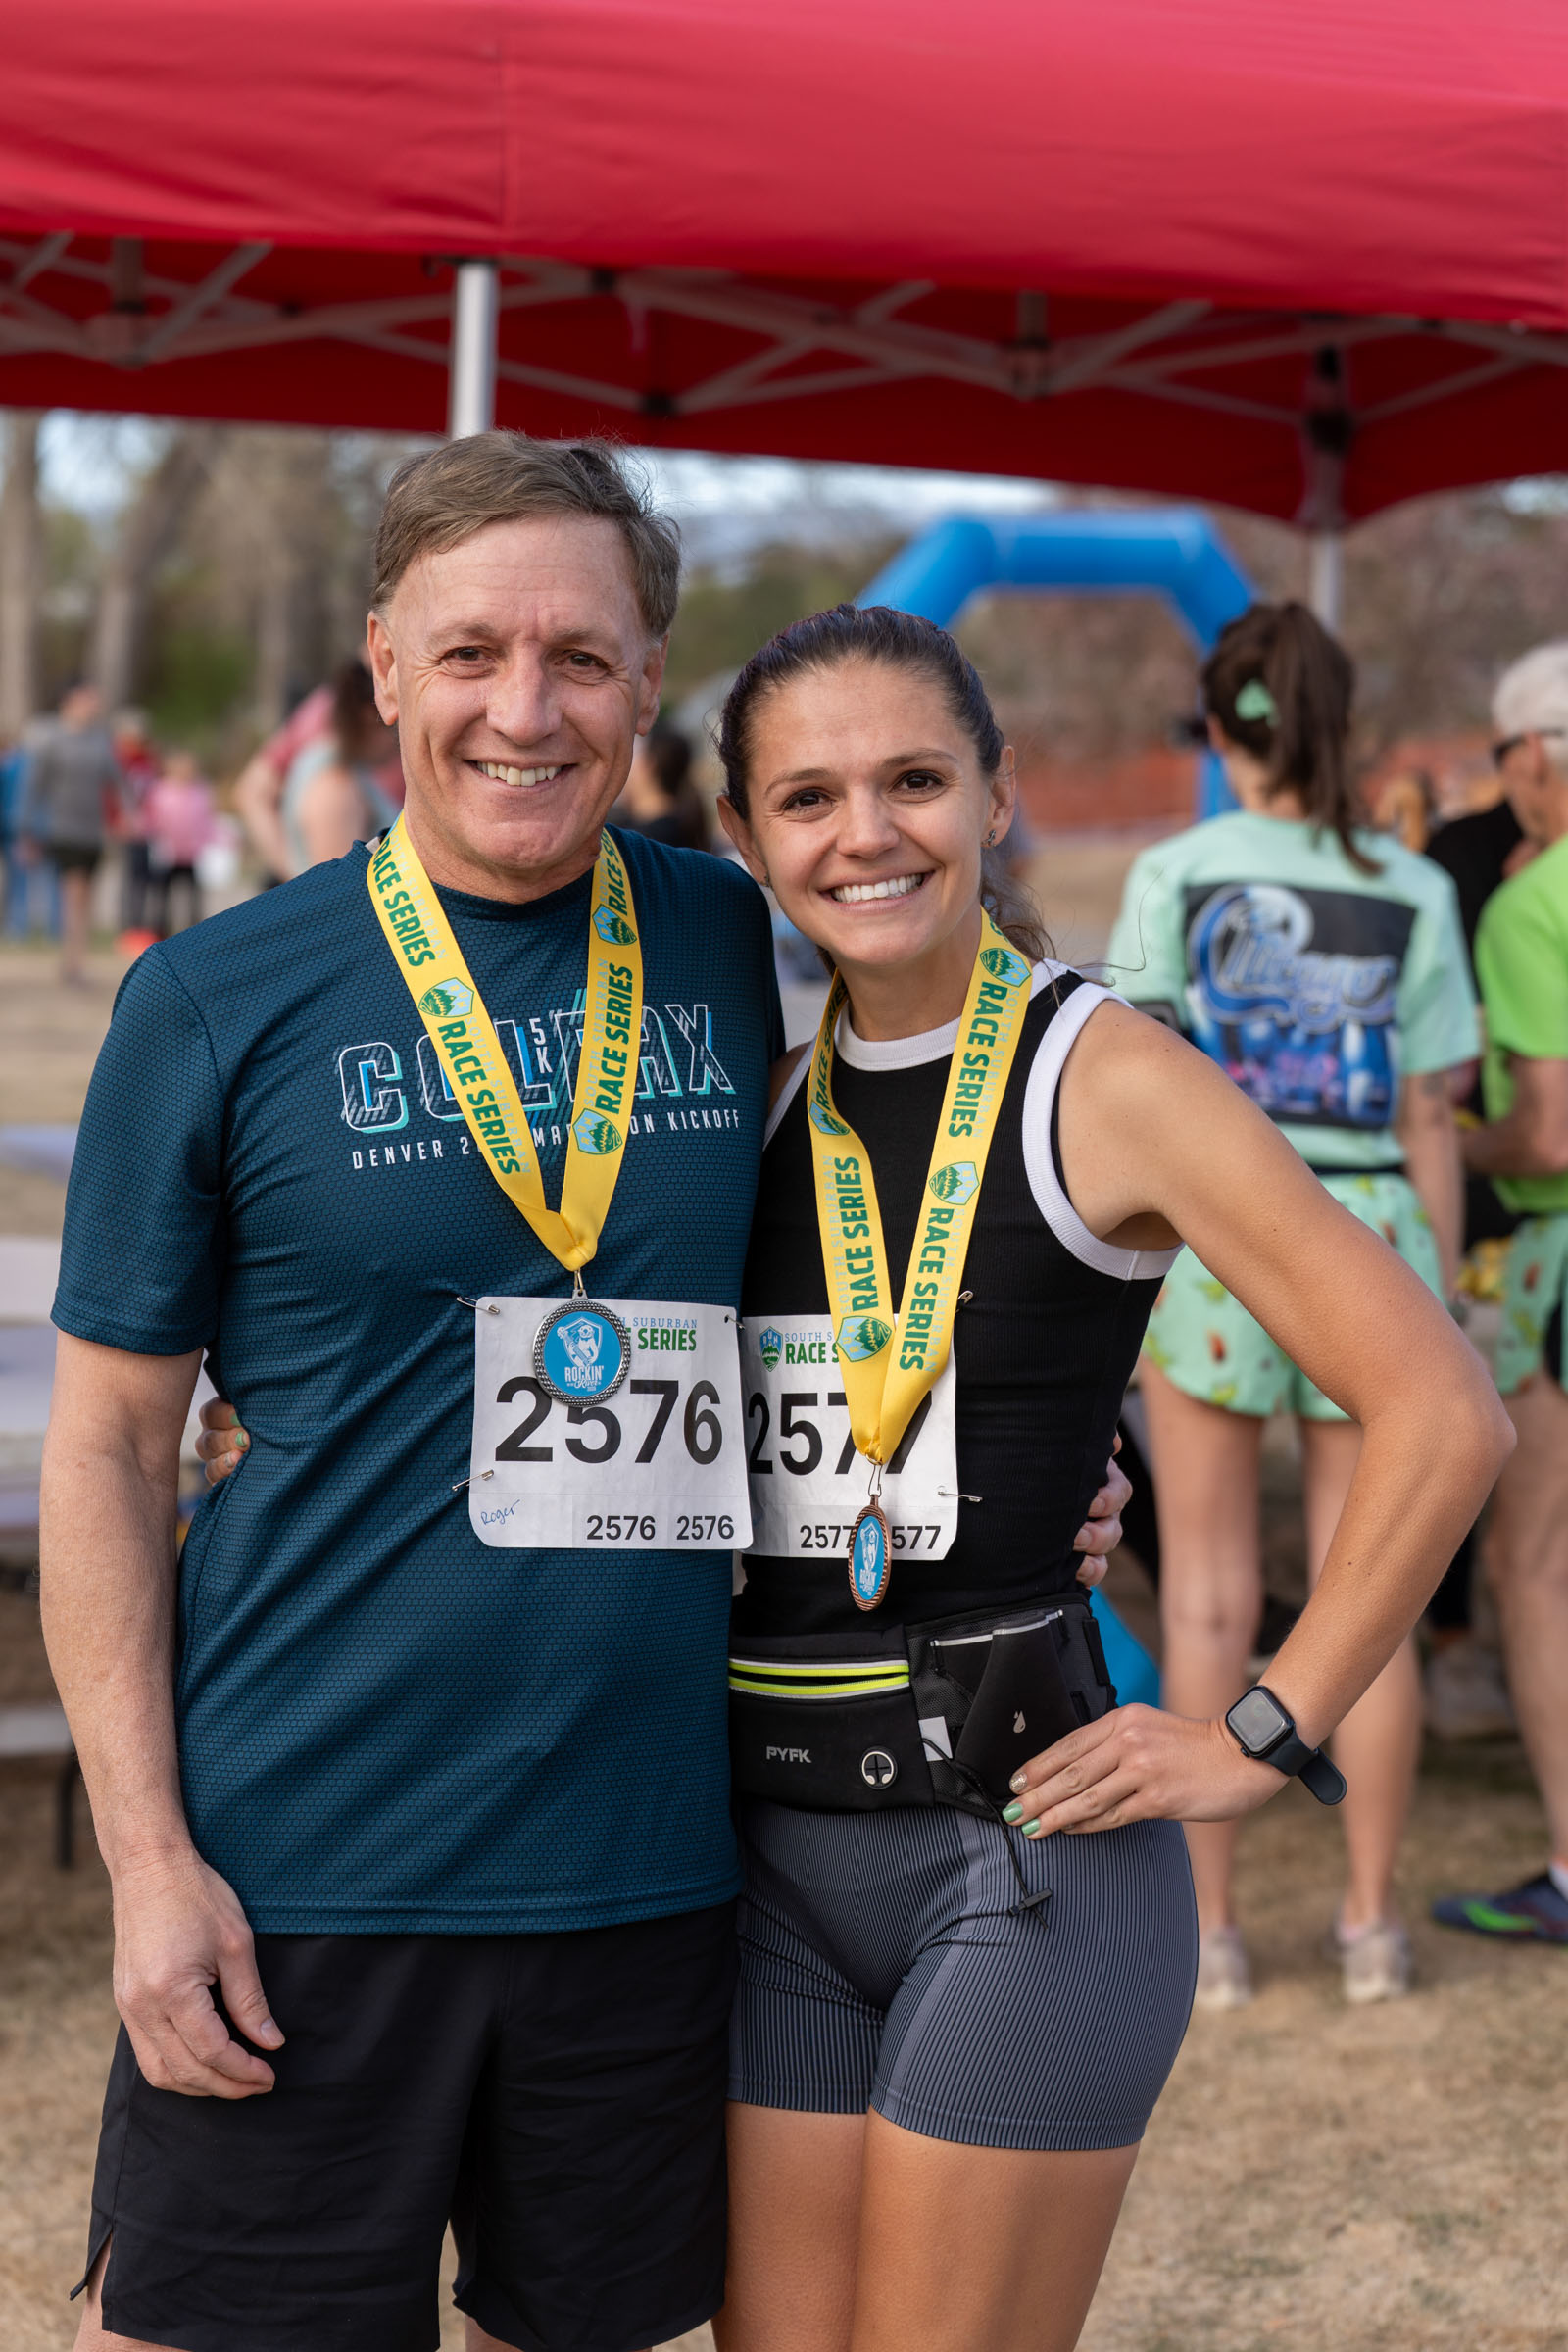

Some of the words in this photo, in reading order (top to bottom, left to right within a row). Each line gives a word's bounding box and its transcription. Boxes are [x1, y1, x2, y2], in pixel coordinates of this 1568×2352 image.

[372, 836, 402, 895] RACE
[607, 857, 628, 917] RACE
[383, 890, 436, 967] SERIES
[404, 877, 449, 960] SUBURBAN
[448, 983, 469, 1010] RUN
[592, 956, 610, 1045] SUBURBAN
[604, 962, 634, 1046] SERIES
[967, 981, 1008, 1048] RACE
[997, 986, 1020, 1044] SOUTH
[437, 1020, 488, 1087] RACE
[466, 1089, 522, 1175] SERIES
[465, 1016, 497, 1073] SOUTH
[489, 1079, 532, 1174] SUBURBAN
[584, 1049, 603, 1108] SOUTH
[594, 1046, 629, 1115] RACE
[815, 1050, 832, 1112] RACE
[948, 1052, 990, 1138] SERIES
[972, 1049, 1004, 1139] SUBURBAN
[352, 1139, 444, 1170] DENVER
[666, 1108, 740, 1132] KICKOFF
[576, 1117, 594, 1145] RUN
[822, 1154, 844, 1248] SUBURBAN
[834, 1156, 870, 1240] SERIES
[957, 1170, 973, 1198] RUN
[917, 1208, 955, 1275] RACE
[945, 1208, 966, 1268] SOUTH
[832, 1255, 852, 1314] SOUTH
[845, 1245, 879, 1312] RACE
[632, 1316, 698, 1329] SUBURBAN
[637, 1328, 697, 1351] SERIES
[784, 1332, 822, 1343] SOUTH
[785, 1342, 826, 1364] RACE
[843, 1326, 858, 1354] RUN
[899, 1282, 939, 1371] SERIES
[924, 1274, 952, 1374] SUBURBAN
[564, 1365, 604, 1382] ROCKIN'
[494, 1375, 723, 1467] 2576
[480, 1499, 521, 1526] Roger
[586, 1514, 656, 1541] 2576
[676, 1514, 735, 1541] 2576
[766, 1745, 812, 1763] PYFK
